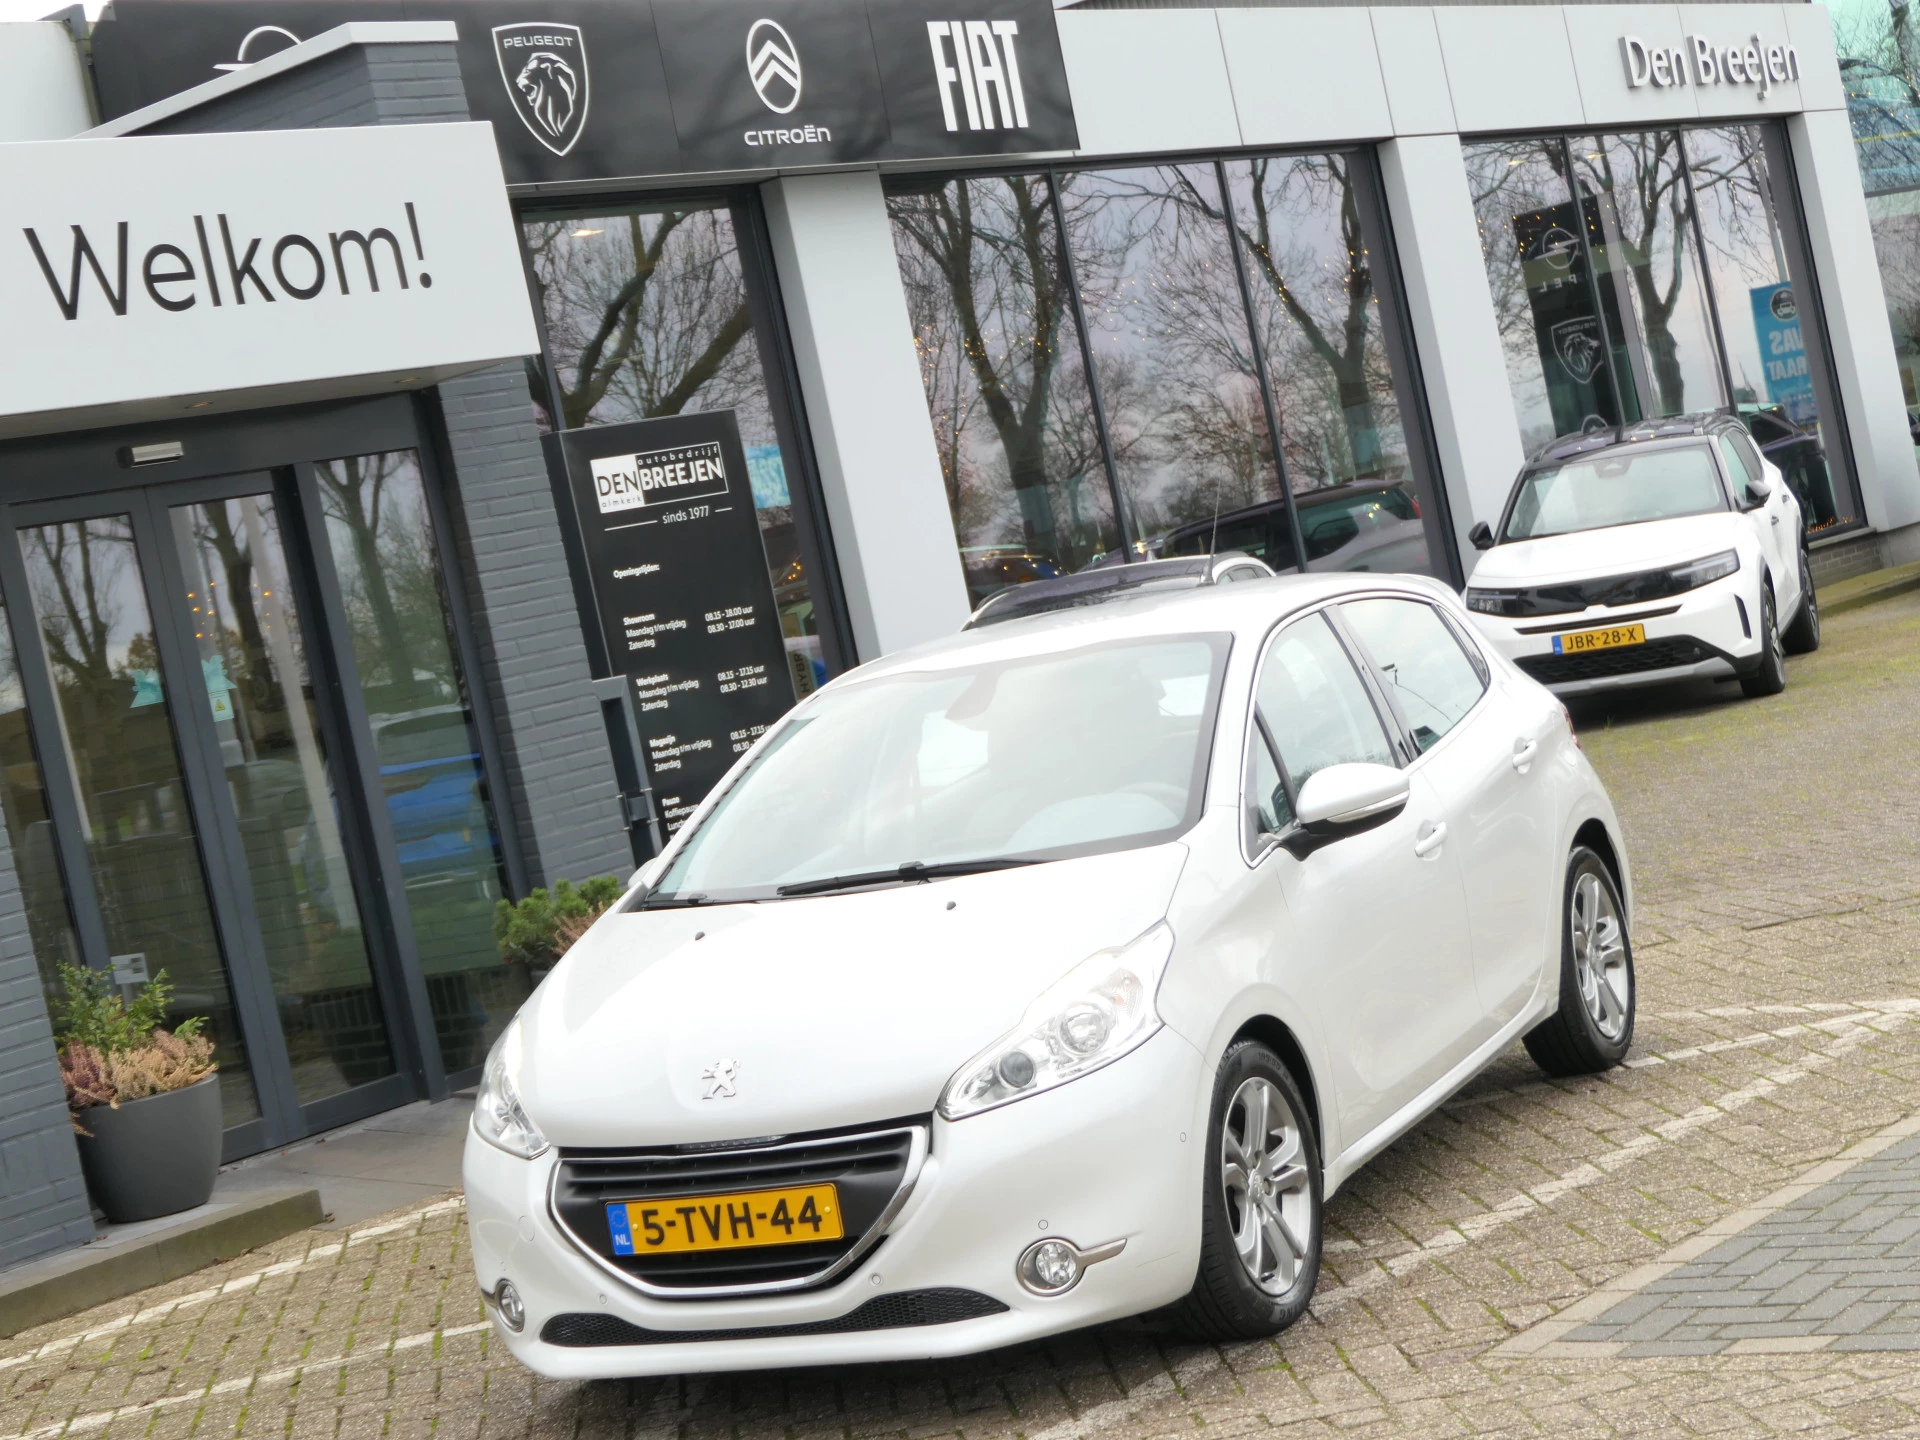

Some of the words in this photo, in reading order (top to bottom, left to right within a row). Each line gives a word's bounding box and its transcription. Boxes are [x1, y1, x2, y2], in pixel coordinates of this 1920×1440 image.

[503, 35, 573, 49] PEUGEOT
[1618, 35, 1688, 88] Den
[1686, 32, 1800, 100] Breejen
[927, 21, 1029, 131] FIAT
[22, 201, 433, 321] Welkom!
[637, 445, 719, 466] autobedrijf
[662, 510, 688, 524] sinds
[688, 505, 709, 520] 1977
[623, 614, 655, 626] Showroom
[705, 611, 721, 622] 08.15
[742, 606, 753, 614] uur
[626, 627, 654, 638] Maandag
[665, 620, 687, 630] vrijdag
[707, 623, 725, 634] 08.30
[744, 618, 755, 626] uur
[628, 639, 655, 650] Zaterdag
[1567, 628, 1638, 650] JBR-28-X
[717, 670, 734, 682] 08.15
[754, 665, 764, 673] uur
[639, 687, 667, 699] Maandag
[678, 680, 700, 691] vrijdag
[720, 682, 737, 693] 08.30
[757, 677, 768, 685] uur
[641, 699, 669, 711] Zaterdag
[651, 747, 680, 759] Maandag
[691, 740, 712, 751] vrijdag
[654, 760, 681, 772] Zaterdag
[615, 1234, 630, 1246] NL
[641, 1195, 822, 1246] 5-TVH-44
